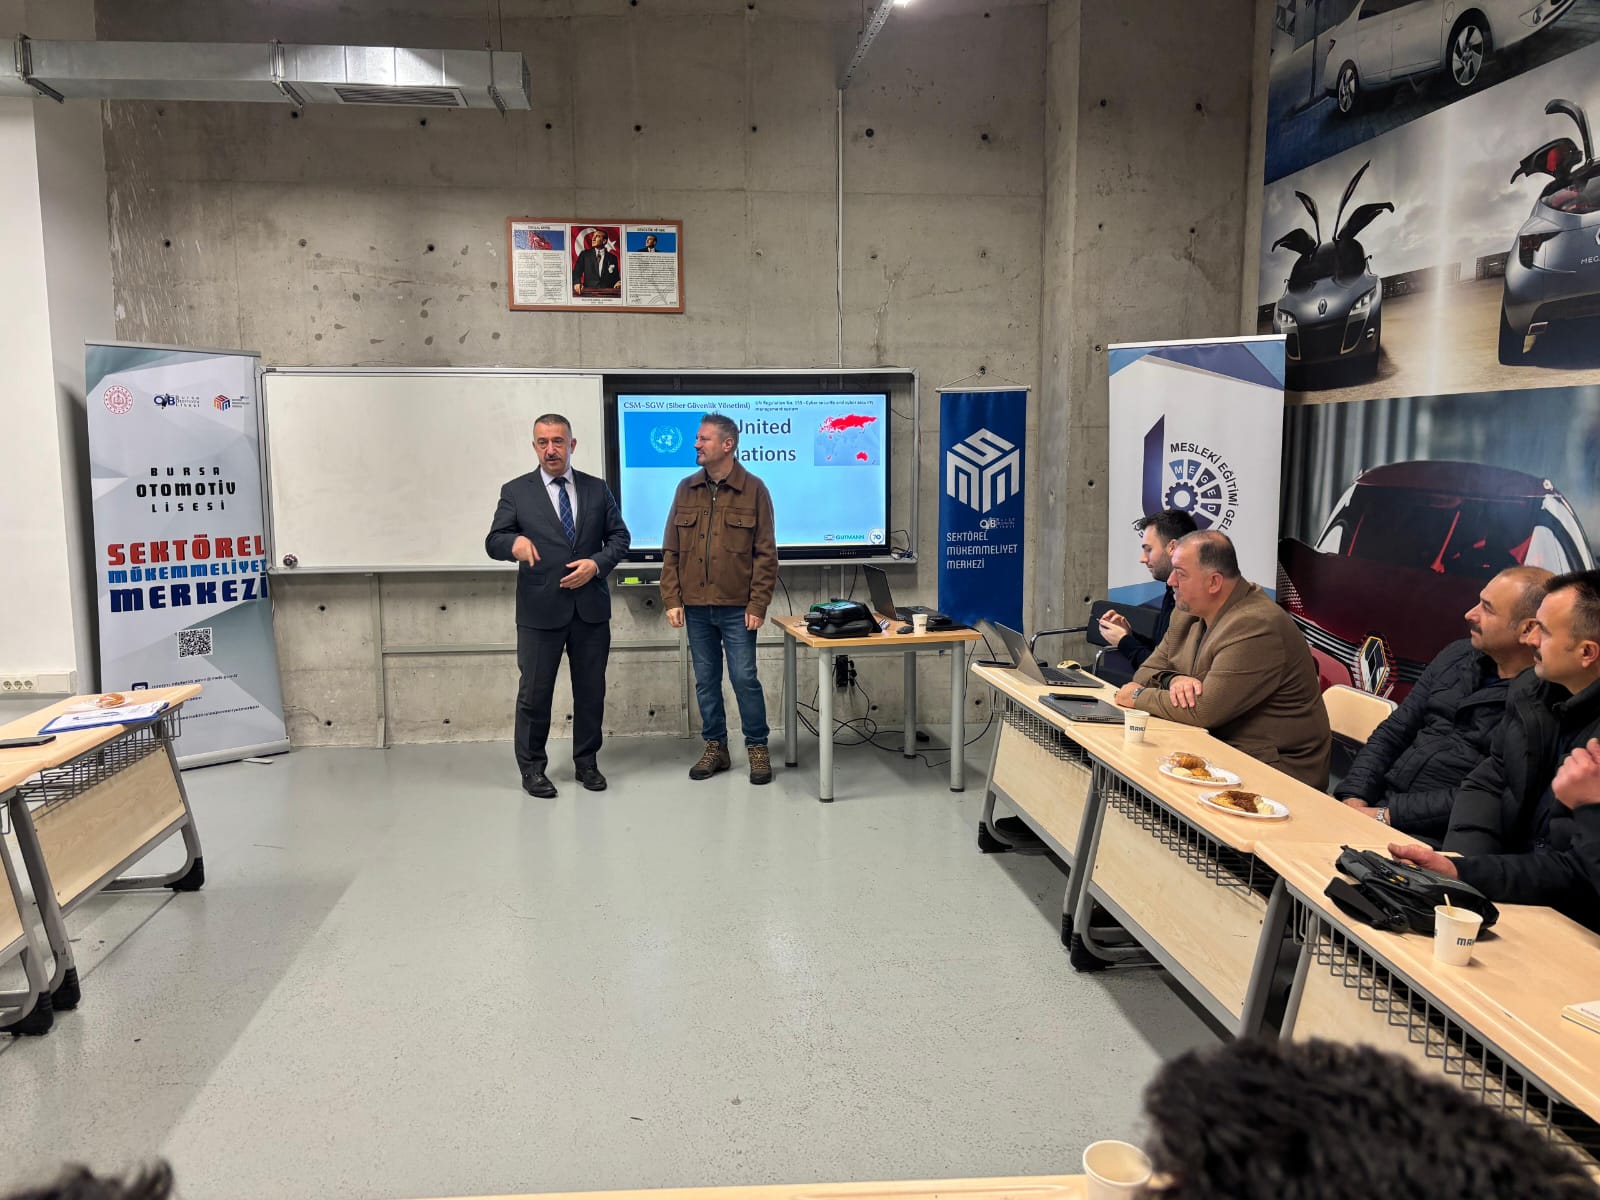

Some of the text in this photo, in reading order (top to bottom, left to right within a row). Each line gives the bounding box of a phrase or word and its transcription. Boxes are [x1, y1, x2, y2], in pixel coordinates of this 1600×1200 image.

[1580, 255, 1600, 265] MEG
[736, 445, 796, 461] ations
[150, 467, 220, 477] BURSA
[136, 479, 236, 498] OTOMOTİV
[1170, 442, 1239, 532] MESLEKİ EĞİTİMİ GEL
[151, 500, 225, 513] LİSESİ
[946, 530, 989, 542] SEKTÖREL
[107, 533, 265, 566] SEKTÖREL
[108, 558, 267, 584] MÜKEMMELİYET
[946, 557, 985, 570] MERKEZİ
[109, 572, 268, 613] MERKEZİ
